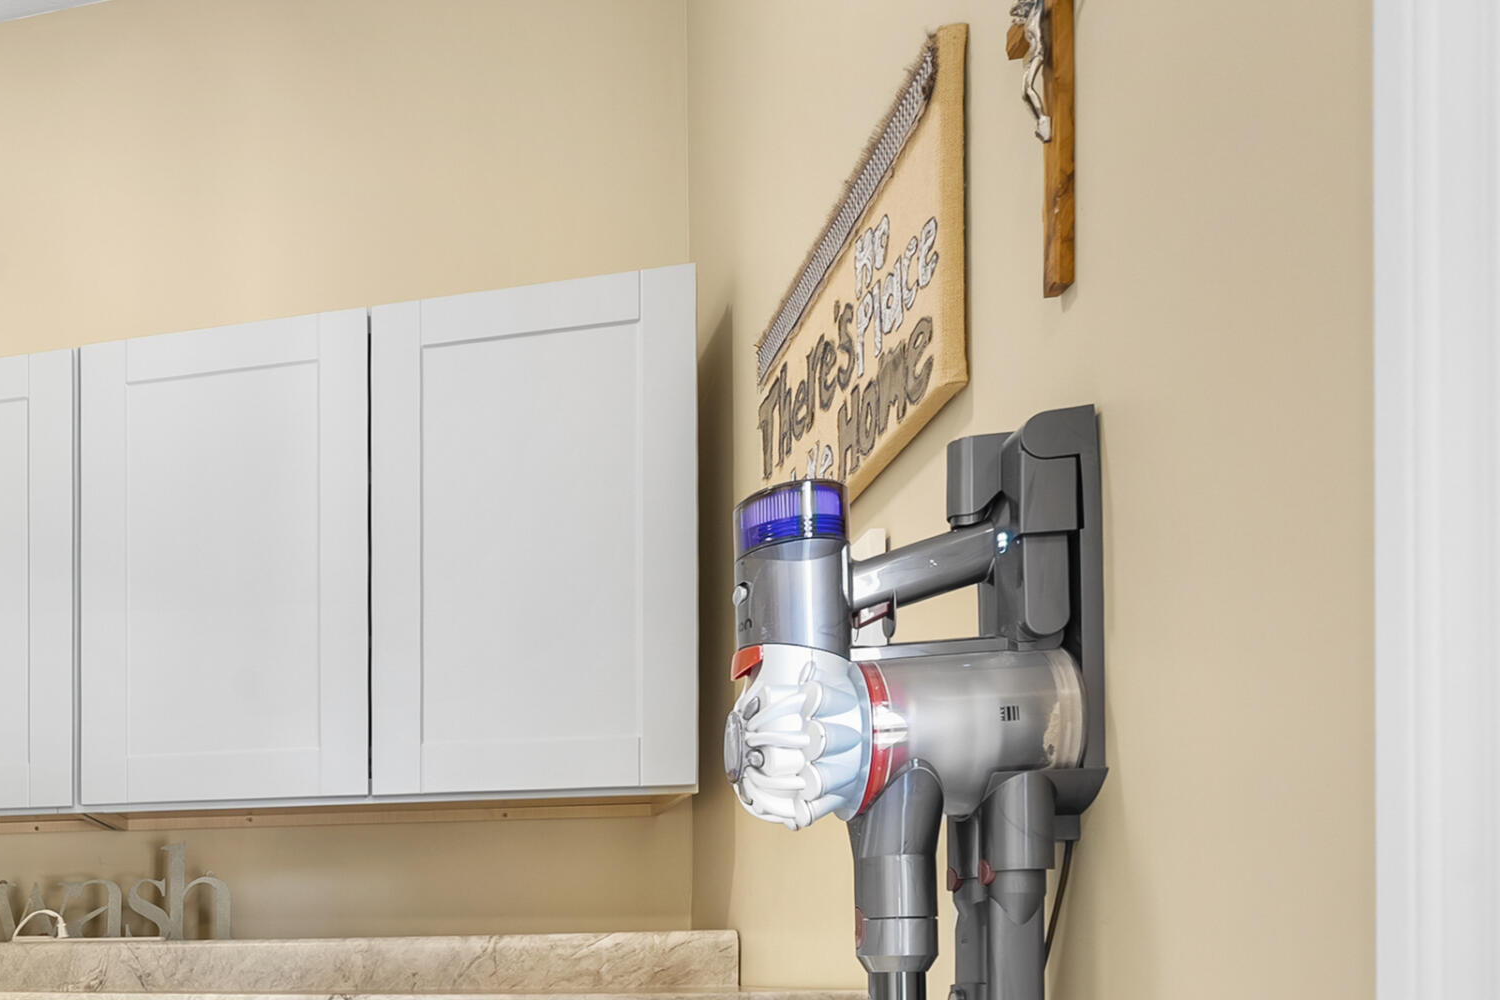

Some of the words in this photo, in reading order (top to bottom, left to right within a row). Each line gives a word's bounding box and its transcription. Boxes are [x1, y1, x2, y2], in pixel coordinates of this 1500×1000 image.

[855, 216, 939, 379] Place
[757, 299, 855, 480] There's
[837, 315, 934, 484] Home
